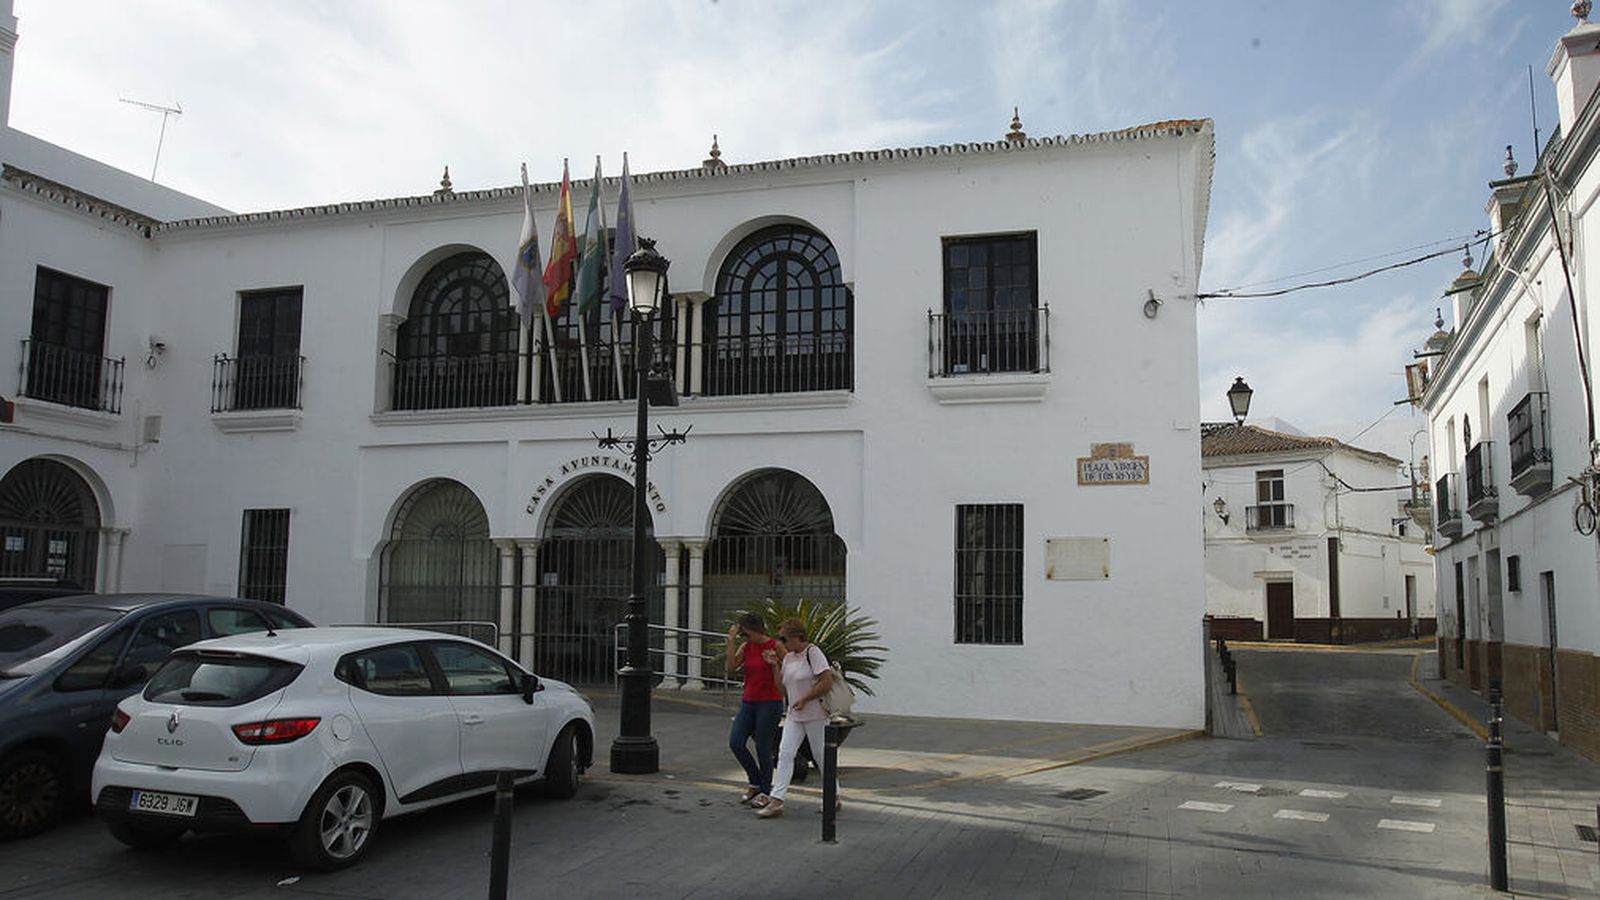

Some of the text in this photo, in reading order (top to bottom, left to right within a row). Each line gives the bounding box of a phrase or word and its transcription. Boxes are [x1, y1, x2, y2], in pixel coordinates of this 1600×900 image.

[1083, 461, 1145, 472] PLAZA VIRGEN
[1085, 471, 1143, 481] DE LOS REYES
[526, 455, 666, 515] CASA AYUNTAMNTO
[157, 737, 184, 746] CLIO
[139, 793, 169, 810] 6329
